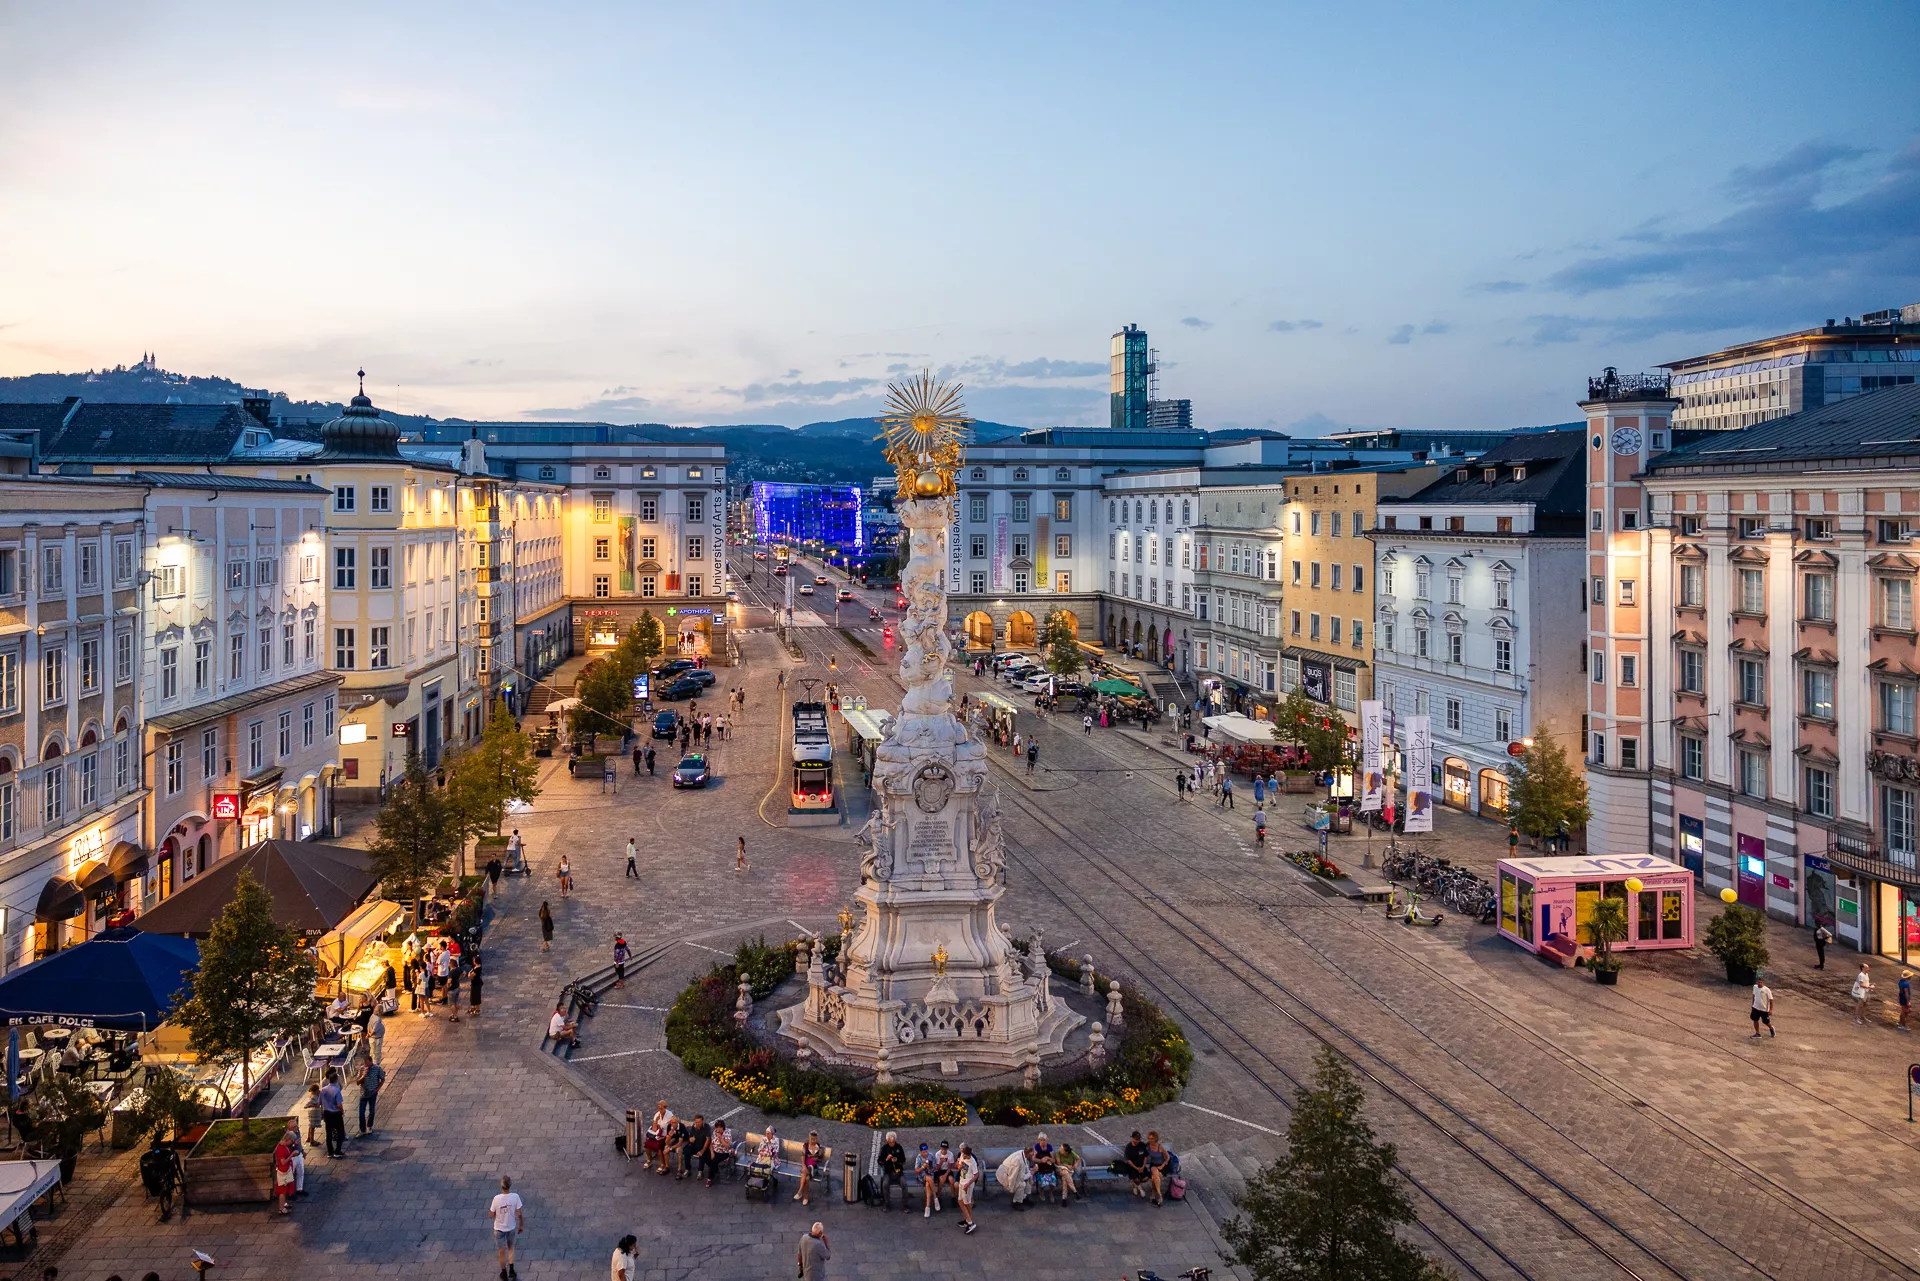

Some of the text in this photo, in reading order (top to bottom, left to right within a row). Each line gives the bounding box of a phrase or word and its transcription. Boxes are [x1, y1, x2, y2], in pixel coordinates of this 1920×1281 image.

[712, 467, 724, 595] University of Arts Linz
[8, 1015, 94, 1027] EIS CAFE DOLCE
